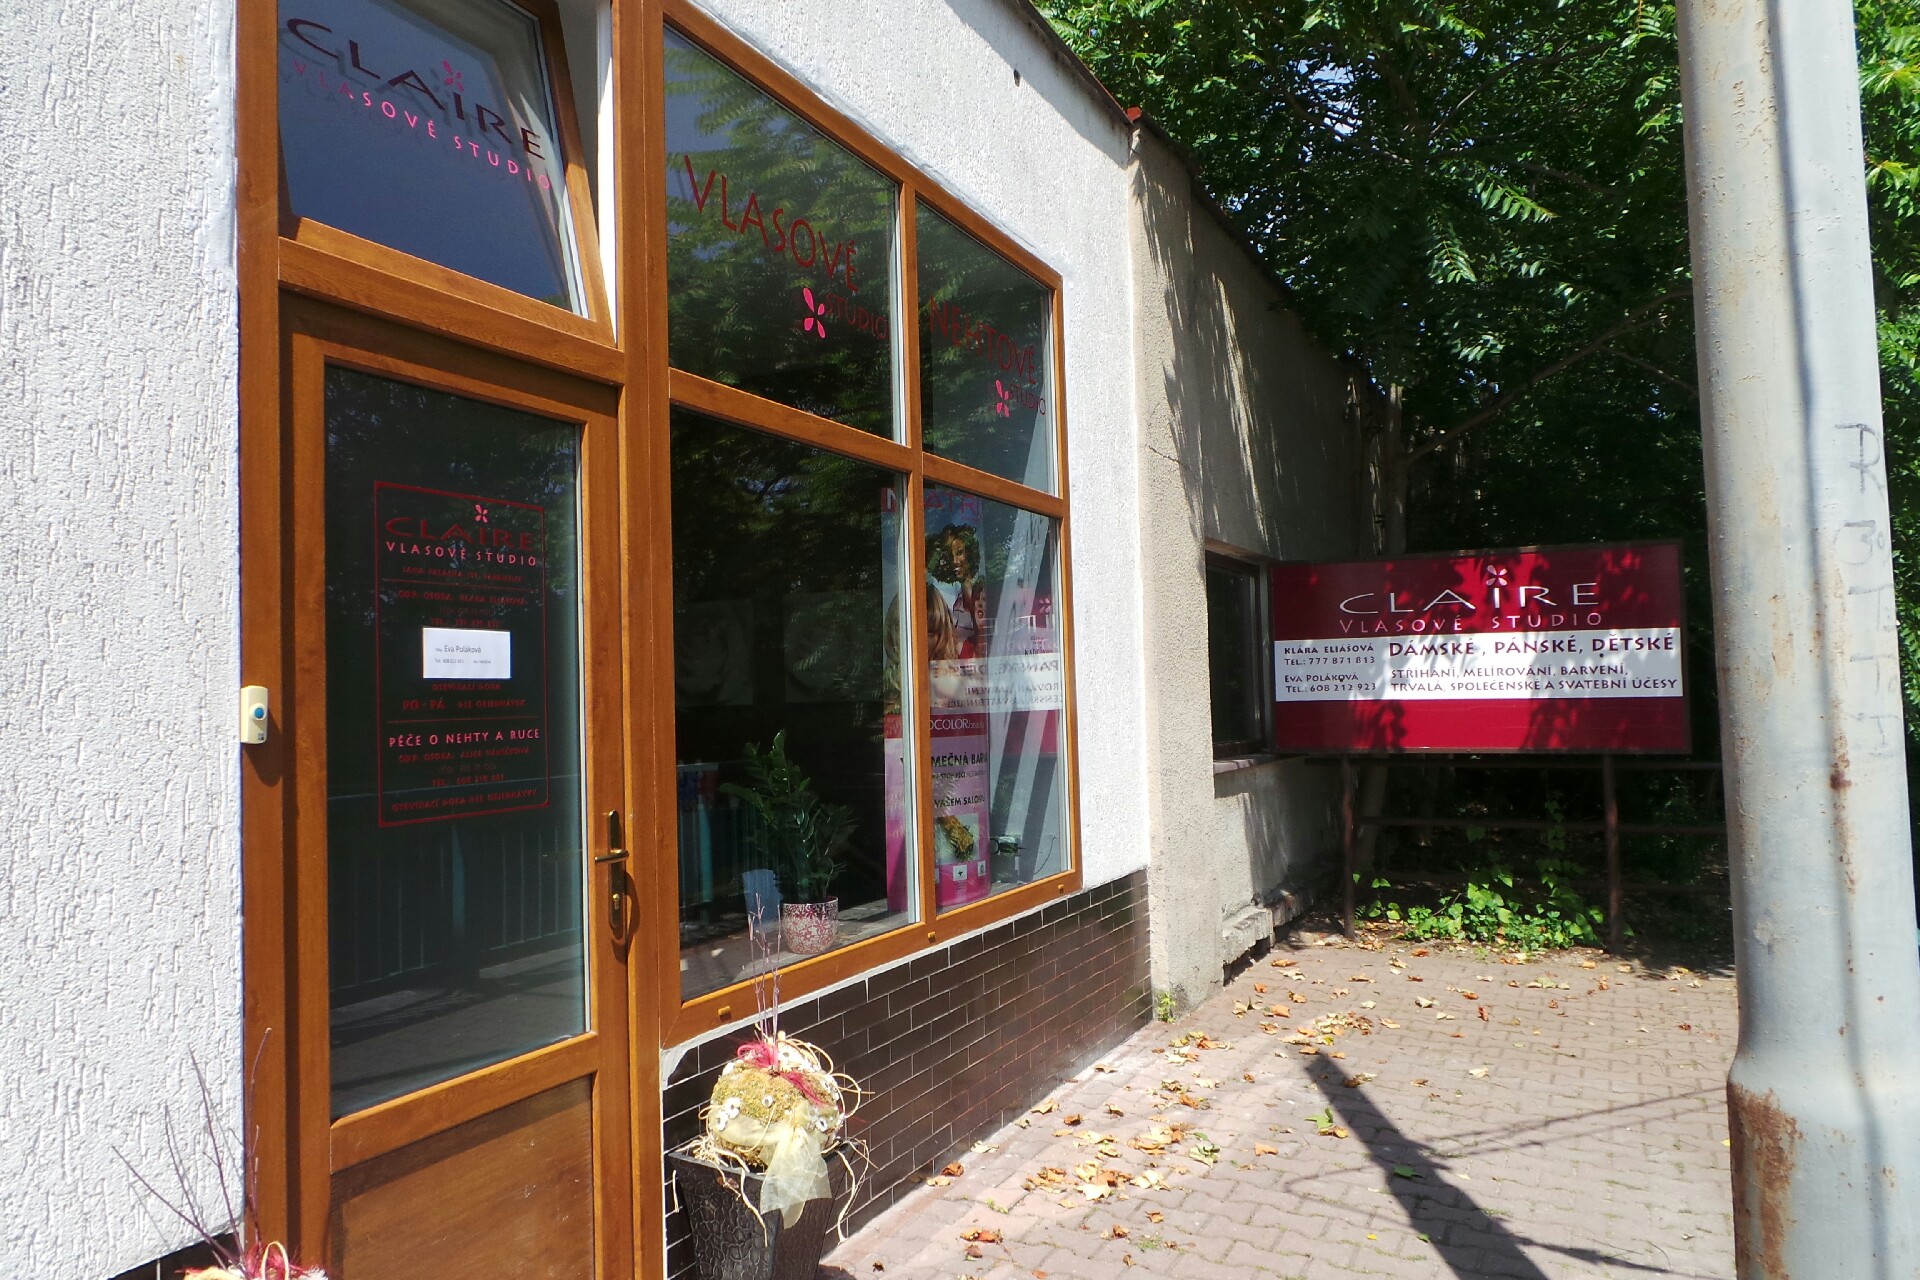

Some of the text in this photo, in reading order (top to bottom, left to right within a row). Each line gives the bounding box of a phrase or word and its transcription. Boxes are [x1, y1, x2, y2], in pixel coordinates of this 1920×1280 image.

[287, 18, 546, 160] CLAIRE
[292, 57, 551, 189] VLASOVÉ STUDIO
[684, 154, 859, 293] VLASOVÉ
[826, 292, 890, 340] STUDIO
[1008, 384, 1046, 416] STUDIO
[385, 517, 537, 550] CLAIRE
[386, 541, 537, 567] VLASOVÉ STUDIO
[1339, 582, 1599, 614] CLAIRE
[1340, 612, 1602, 633] VLASOVÉ STUDIO
[444, 644, 455, 653] Eva
[1284, 643, 1375, 655] KLÁRA ELIÁŠOVÁ
[1494, 635, 1583, 655] PÁNSKÉ,
[1592, 633, 1675, 652] DĚTSKÉ
[1308, 657, 1328, 665] 777
[1332, 656, 1352, 665] 871
[1355, 656, 1375, 664] 813
[1560, 662, 1628, 676] BARVENÍ,
[1284, 671, 1359, 683] EVA POLÁKOVÁ
[1310, 684, 1330, 693] 608
[1334, 683, 1354, 692] 212
[1357, 682, 1376, 691] 923
[1450, 678, 1541, 692] SPOLEČENSKÉ
[1544, 680, 1555, 690] A
[1558, 676, 1627, 690] SVATEBNÍ
[1632, 676, 1678, 690] ÚČESY
[389, 728, 540, 748] PÉČE O NEHTY A RUCE
